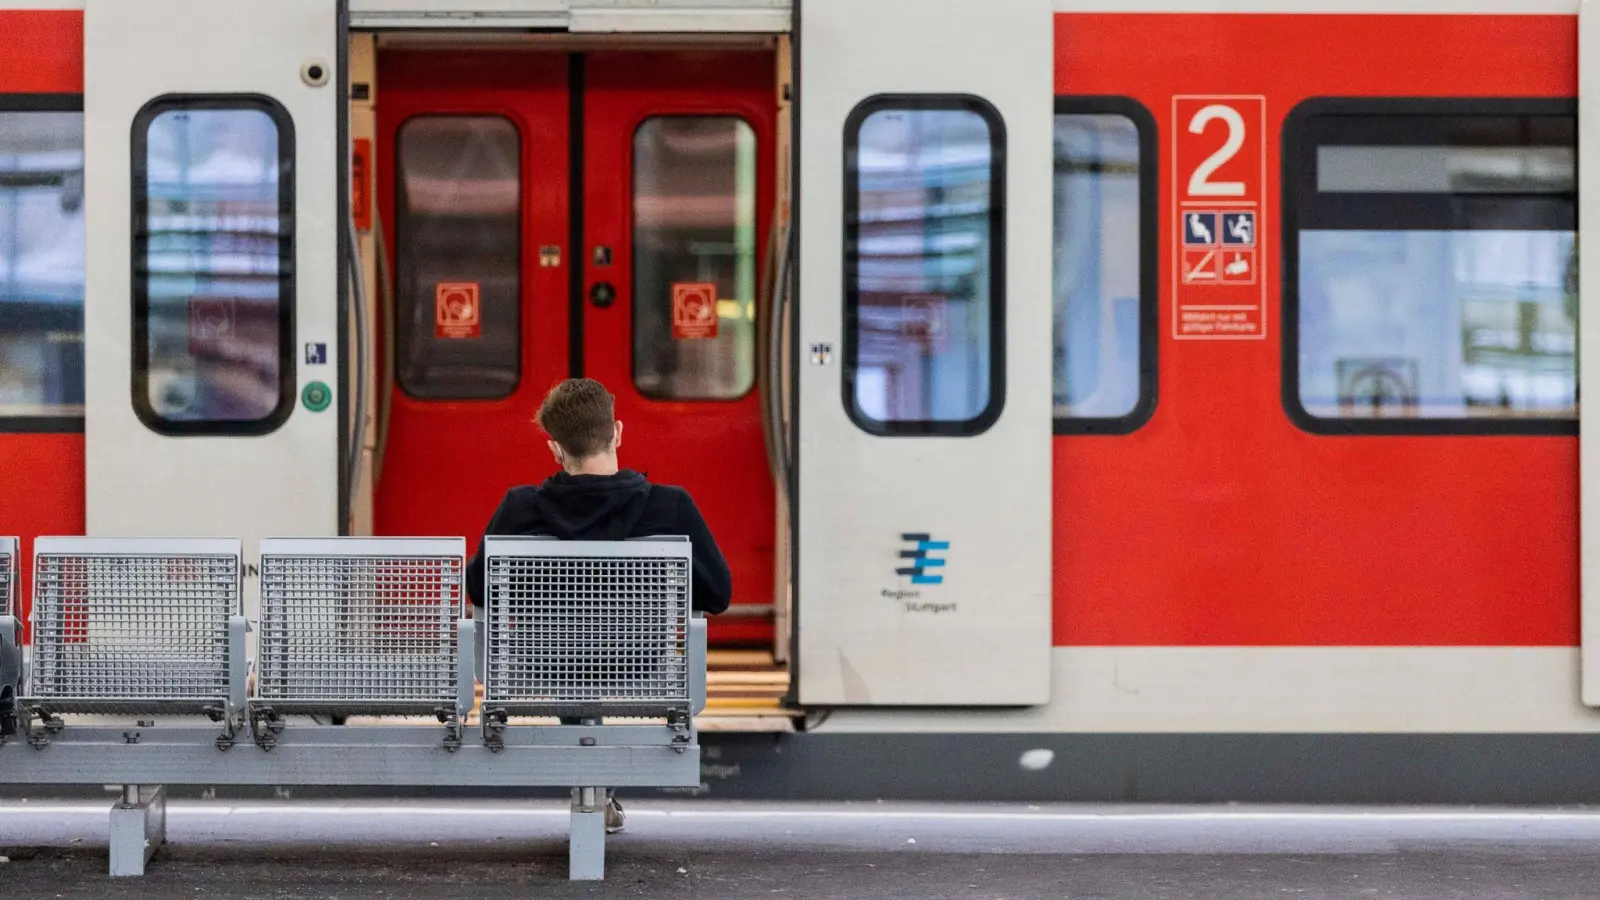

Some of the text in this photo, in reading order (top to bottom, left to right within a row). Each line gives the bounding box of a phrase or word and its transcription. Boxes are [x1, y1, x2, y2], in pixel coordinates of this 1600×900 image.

[1187, 104, 1246, 196] 2
[880, 588, 920, 600] Region
[905, 601, 957, 614] Stuttgart
